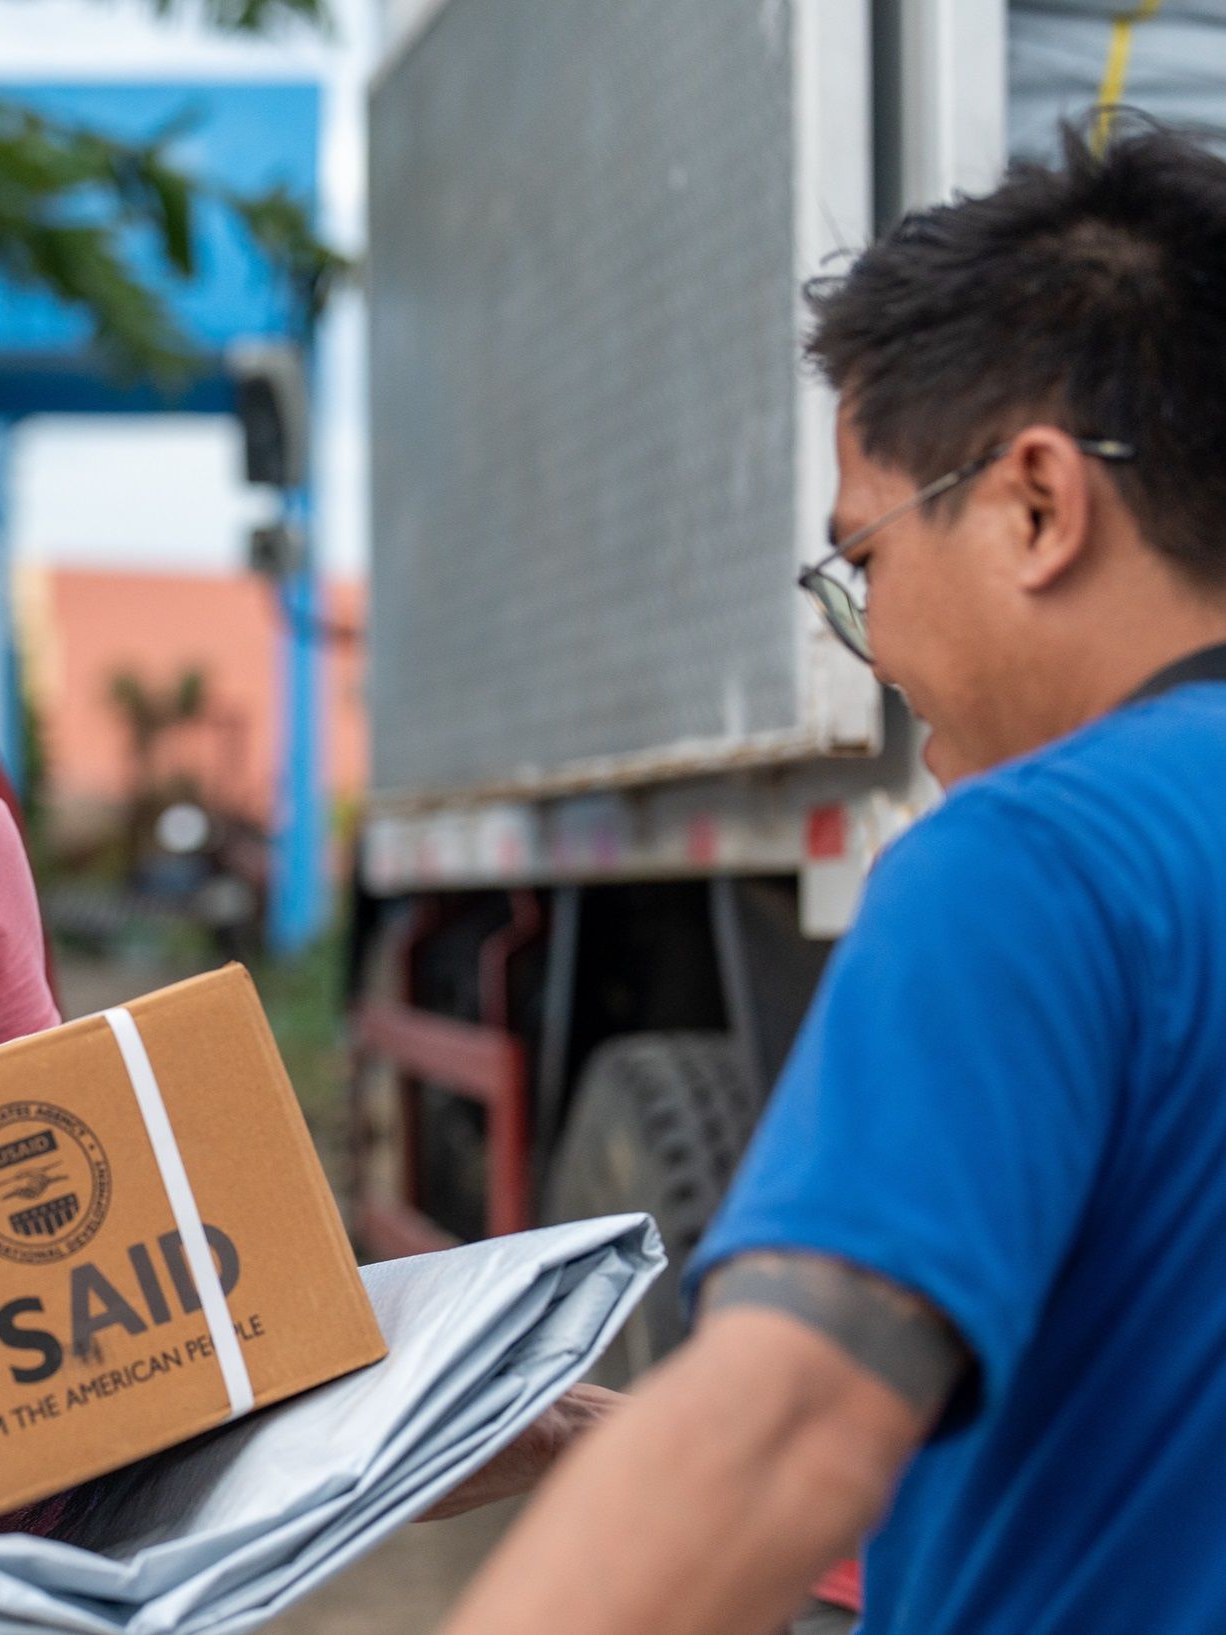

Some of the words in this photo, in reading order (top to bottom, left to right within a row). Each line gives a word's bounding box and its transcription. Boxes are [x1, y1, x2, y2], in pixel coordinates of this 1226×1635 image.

[35, 1105, 88, 1138] AGENCY
[11, 1395, 61, 1436] THE
[67, 1345, 182, 1409] AMERICAN
[185, 1314, 265, 1362] PELE
